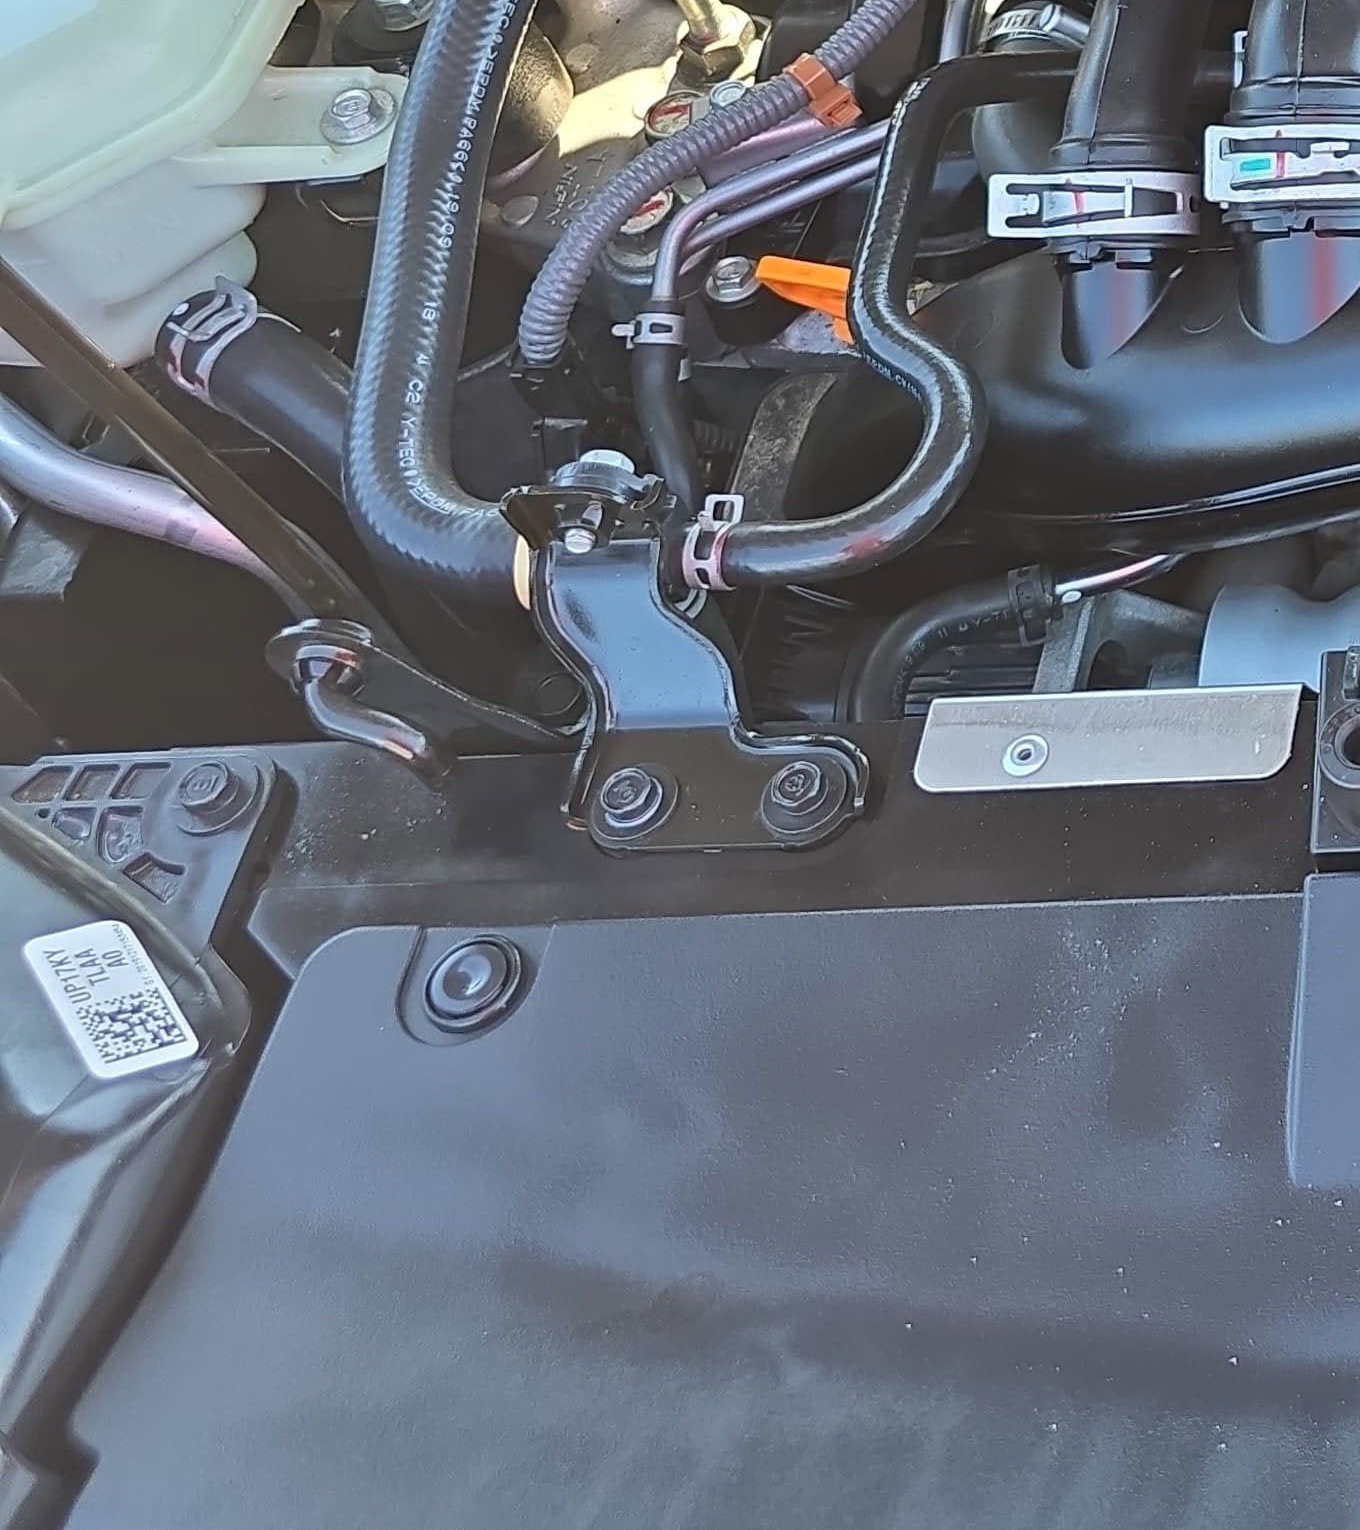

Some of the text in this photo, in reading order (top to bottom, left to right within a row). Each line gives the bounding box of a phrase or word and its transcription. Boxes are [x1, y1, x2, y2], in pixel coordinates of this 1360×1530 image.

[406, 378, 423, 404] C2
[42, 949, 92, 1004] UP17KY
[74, 948, 110, 986] TLAA
